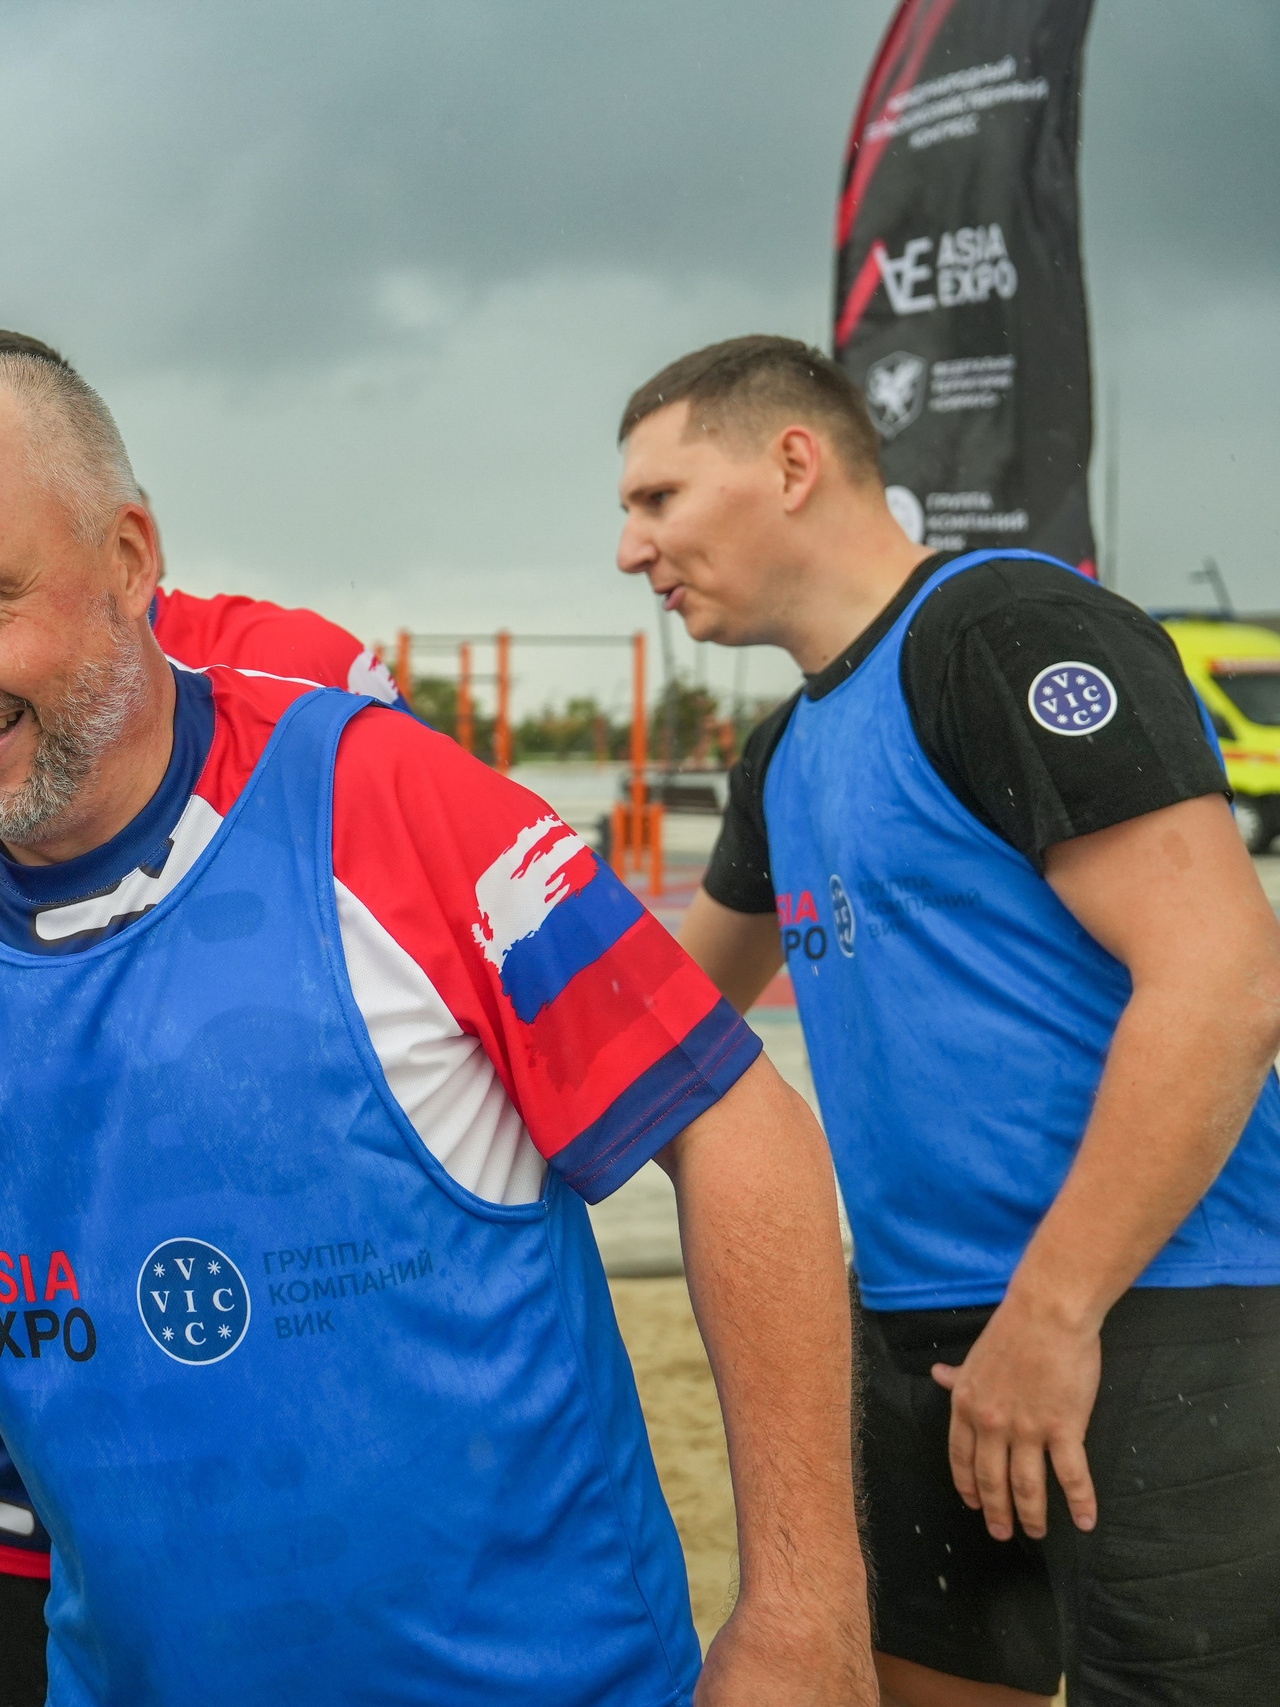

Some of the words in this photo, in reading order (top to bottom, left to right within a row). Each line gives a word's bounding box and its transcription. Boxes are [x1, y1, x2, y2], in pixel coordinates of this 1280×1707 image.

[936, 222, 1009, 267] ASIA
[937, 258, 1018, 308] EXPO
[1040, 684, 1101, 714] VIC
[776, 890, 819, 927] SIA
[785, 926, 827, 959] PO
[262, 1238, 378, 1275] ГРУППА
[269, 1247, 434, 1307] КОМПАНИЙ
[150, 1287, 235, 1313] VIC
[274, 1309, 336, 1340] ВИК
